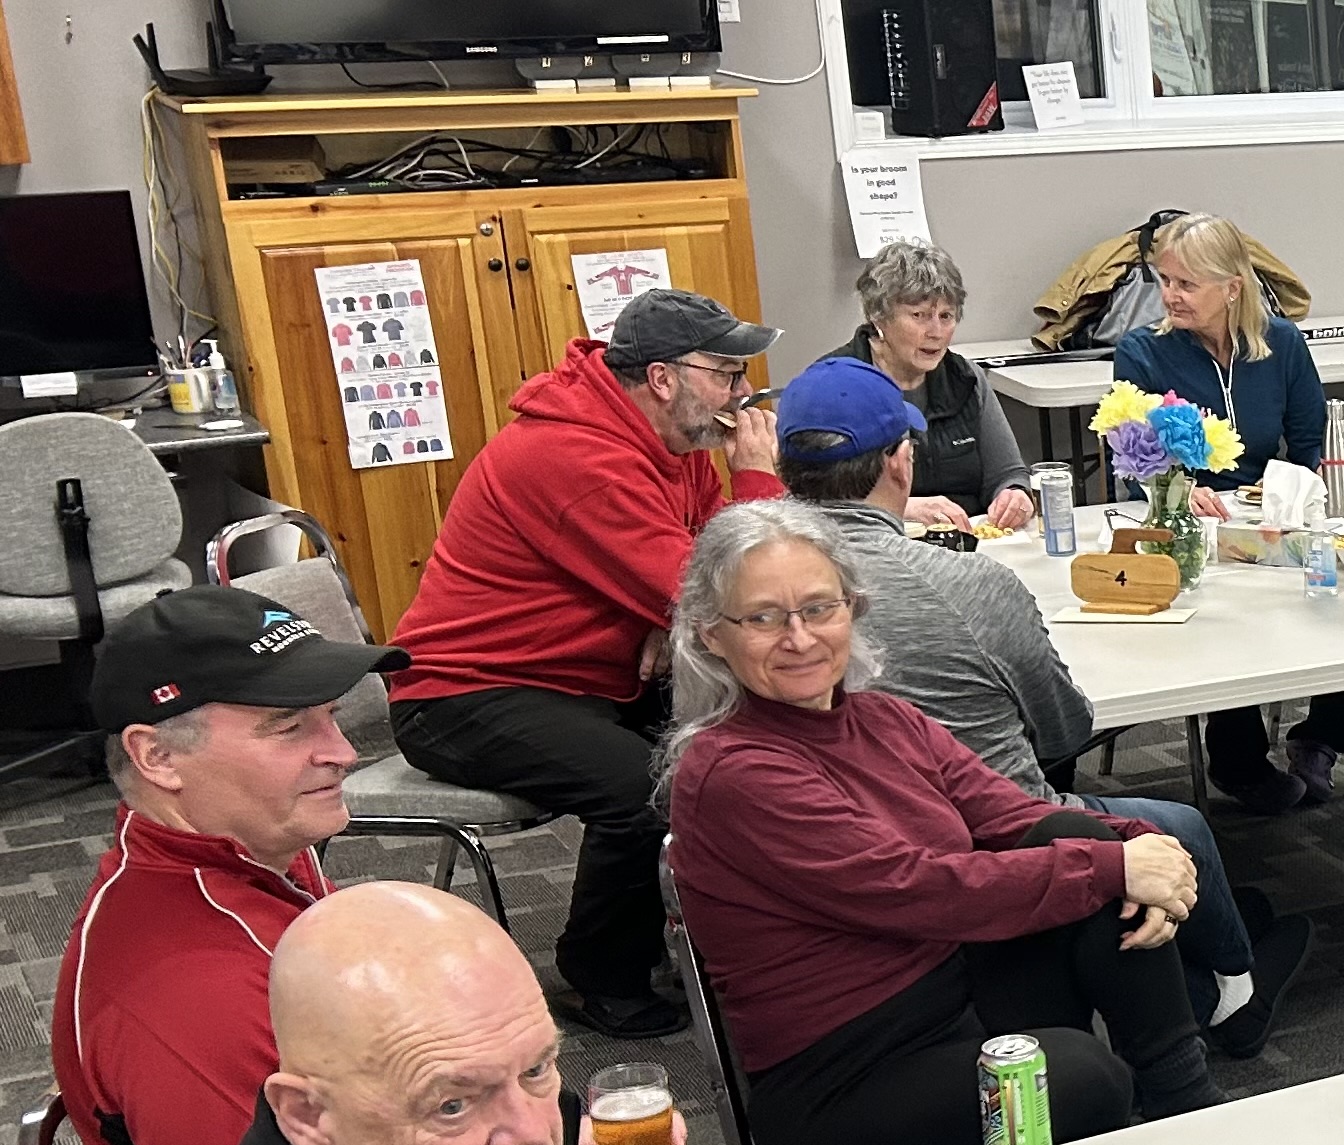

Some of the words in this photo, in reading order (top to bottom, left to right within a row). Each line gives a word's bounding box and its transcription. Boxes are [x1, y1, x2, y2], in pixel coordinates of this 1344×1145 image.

[880, 165, 908, 173] broom
[876, 179, 896, 187] good
[870, 192, 898, 201] shape?
[1115, 570, 1127, 586] 4
